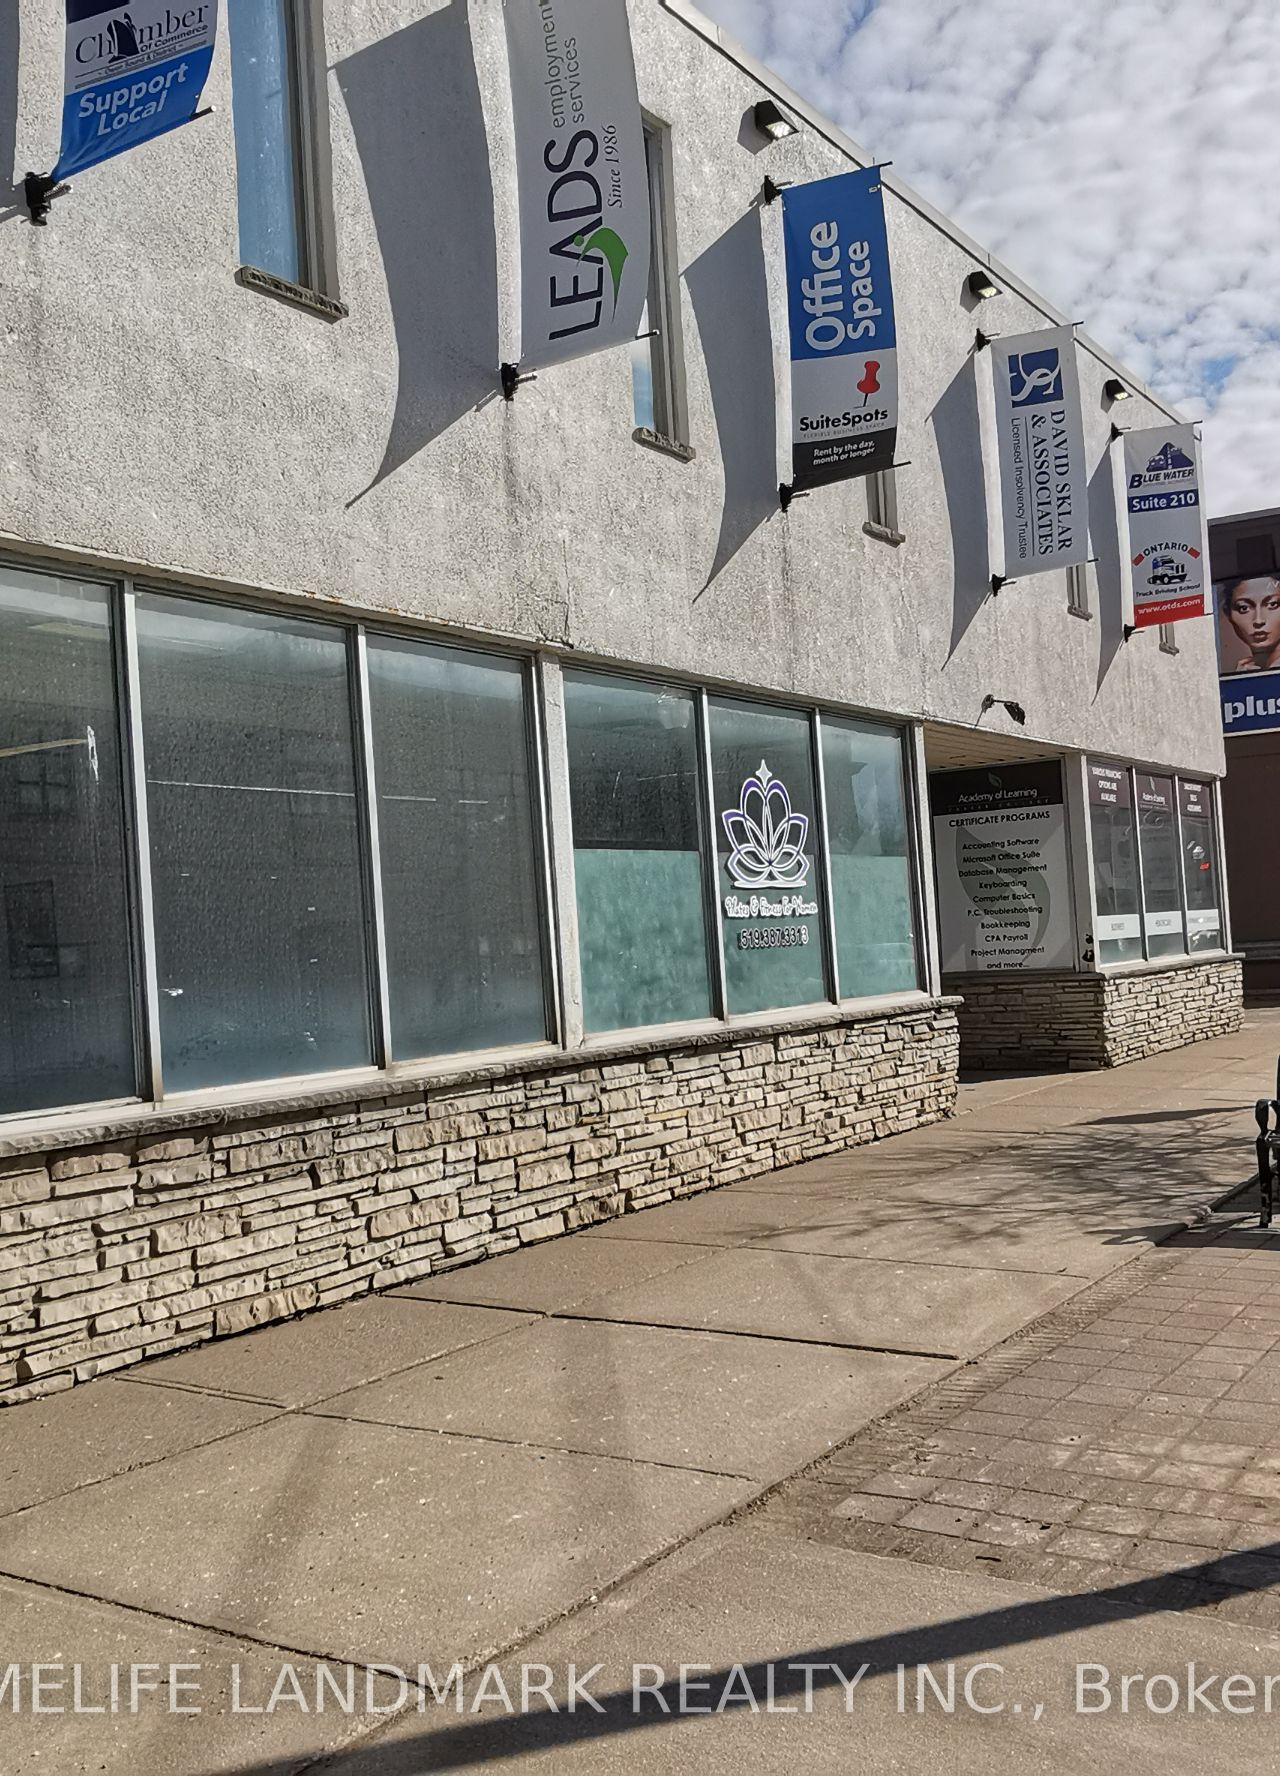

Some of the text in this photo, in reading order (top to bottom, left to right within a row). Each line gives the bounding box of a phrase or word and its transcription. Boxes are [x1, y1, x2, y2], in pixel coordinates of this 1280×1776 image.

[154, 25, 209, 49] Commerce
[78, 62, 189, 118] Support
[564, 37, 585, 125] services
[97, 90, 168, 136] Local
[601, 125, 623, 209] Since 1986
[543, 130, 604, 341] LEADS
[801, 221, 846, 351] Office
[847, 241, 882, 340] Space
[799, 408, 888, 432] SuiteSpots
[813, 447, 876, 466] month or longer
[814, 447, 833, 457] Rent
[833, 445, 843, 454] by
[844, 443, 858, 452] the
[1011, 417, 1027, 559] Licensed Insolvency Trustee
[1031, 413, 1054, 556] & ASSOCIATES
[1050, 409, 1073, 552] DAVID SKLAR
[1129, 472, 1161, 489] BLUE
[1163, 468, 1195, 481] WATER
[1132, 492, 1196, 511] Suite 210
[1142, 541, 1189, 557] ONTARIO
[1137, 599, 1201, 615] www.otds.com
[958, 788, 1038, 803] Academy of Learning
[948, 810, 1051, 828] CERTIFICATE PROGRAMS
[962, 838, 1040, 850] Accounting Software
[962, 850, 1041, 863] Microsoft Office Suite
[958, 863, 1048, 878] Database Management
[978, 879, 1028, 890] Keyboarding
[972, 892, 1036, 904] Computer Basics
[983, 905, 1043, 916] Troubleshooting
[980, 920, 1031, 931] Bookkeeping
[740, 925, 809, 949] 519.387.3313
[984, 933, 1029, 944] CPA Payroll
[970, 949, 997, 959] Project
[986, 961, 1002, 970] and
